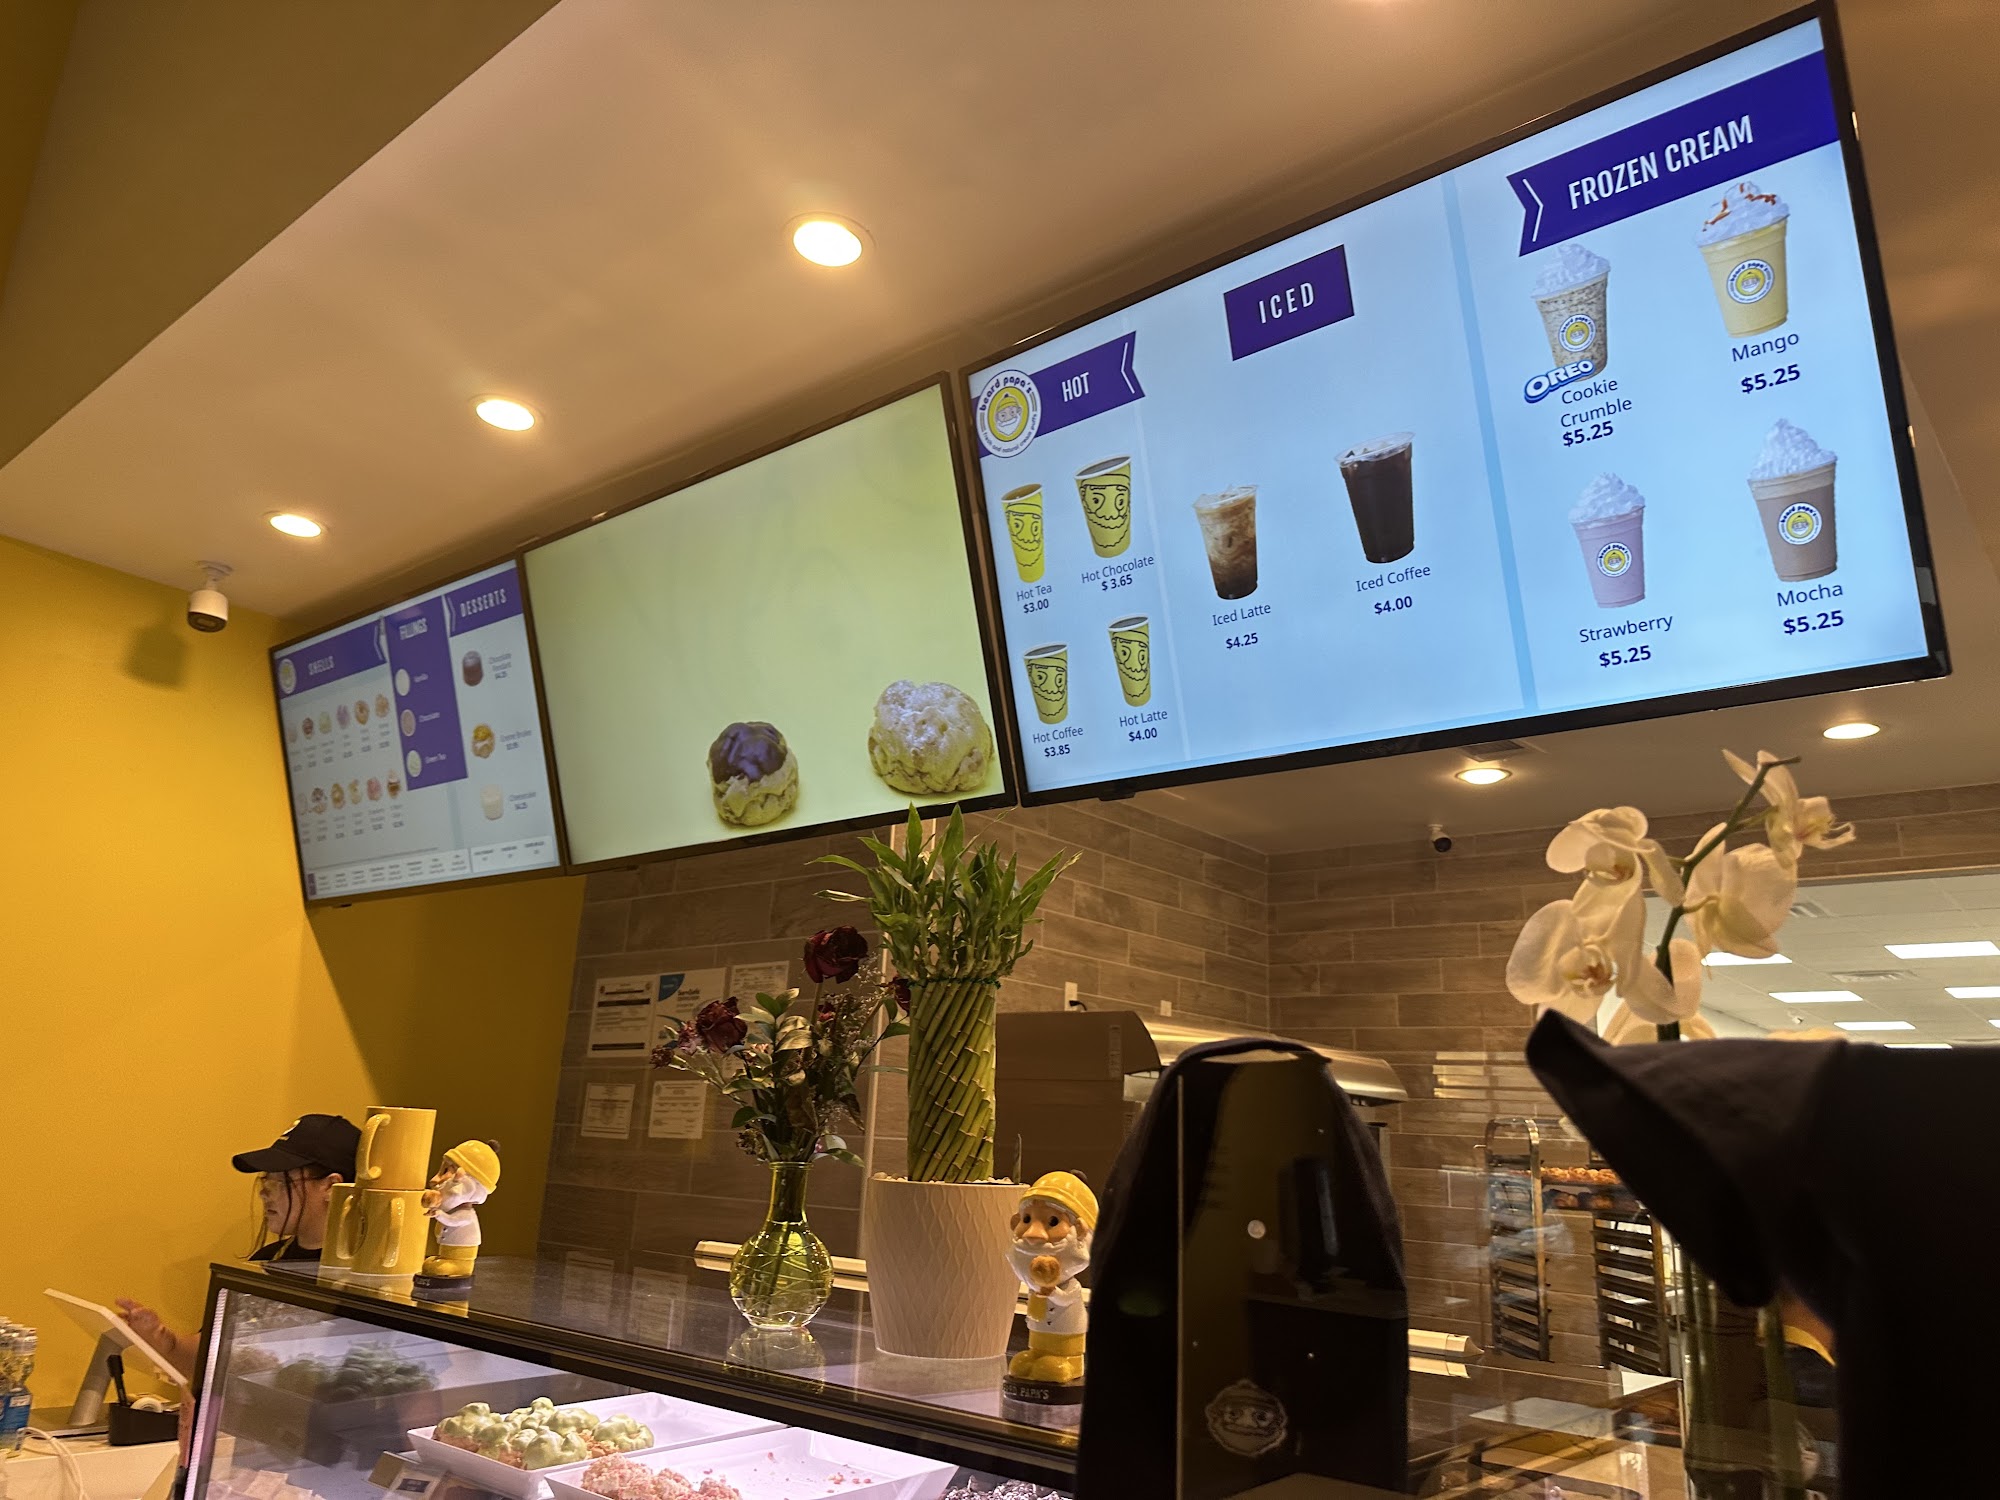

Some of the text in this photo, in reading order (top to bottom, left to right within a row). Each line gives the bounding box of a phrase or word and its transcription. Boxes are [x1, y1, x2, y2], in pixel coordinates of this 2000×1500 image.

[1567, 114, 1754, 210] FROZEN CREAM
[1258, 282, 1315, 324] ICED
[1731, 332, 1800, 362] Mango
[1061, 372, 1090, 402] HOT
[1524, 359, 1595, 403] OREO
[1561, 377, 1619, 405] Cookie
[1740, 363, 1801, 395] $5.25
[979, 376, 1032, 411] beard papa's
[1560, 397, 1633, 428] Crumble
[1562, 420, 1614, 448] $5.25
[1081, 555, 1155, 584] Hot Chocolate
[1356, 565, 1431, 592] Iced Coffee
[460, 588, 507, 618] DESSERTS
[1016, 583, 1052, 602] Hot Tea
[1023, 598, 1050, 614] $3.00
[1373, 595, 1413, 615] $4.00
[1776, 583, 1844, 607] Mocha
[1212, 603, 1272, 626] Iced Latte
[1782, 609, 1844, 635] $5.25
[1225, 632, 1259, 650] $4.25
[1579, 614, 1674, 643] Strawberry
[1599, 644, 1652, 668] $5.25
[1119, 709, 1168, 727] Hot Latte
[1032, 726, 1084, 744] Hot Coffee
[1128, 727, 1158, 743] $4.00
[1044, 744, 1071, 758] $3.85
